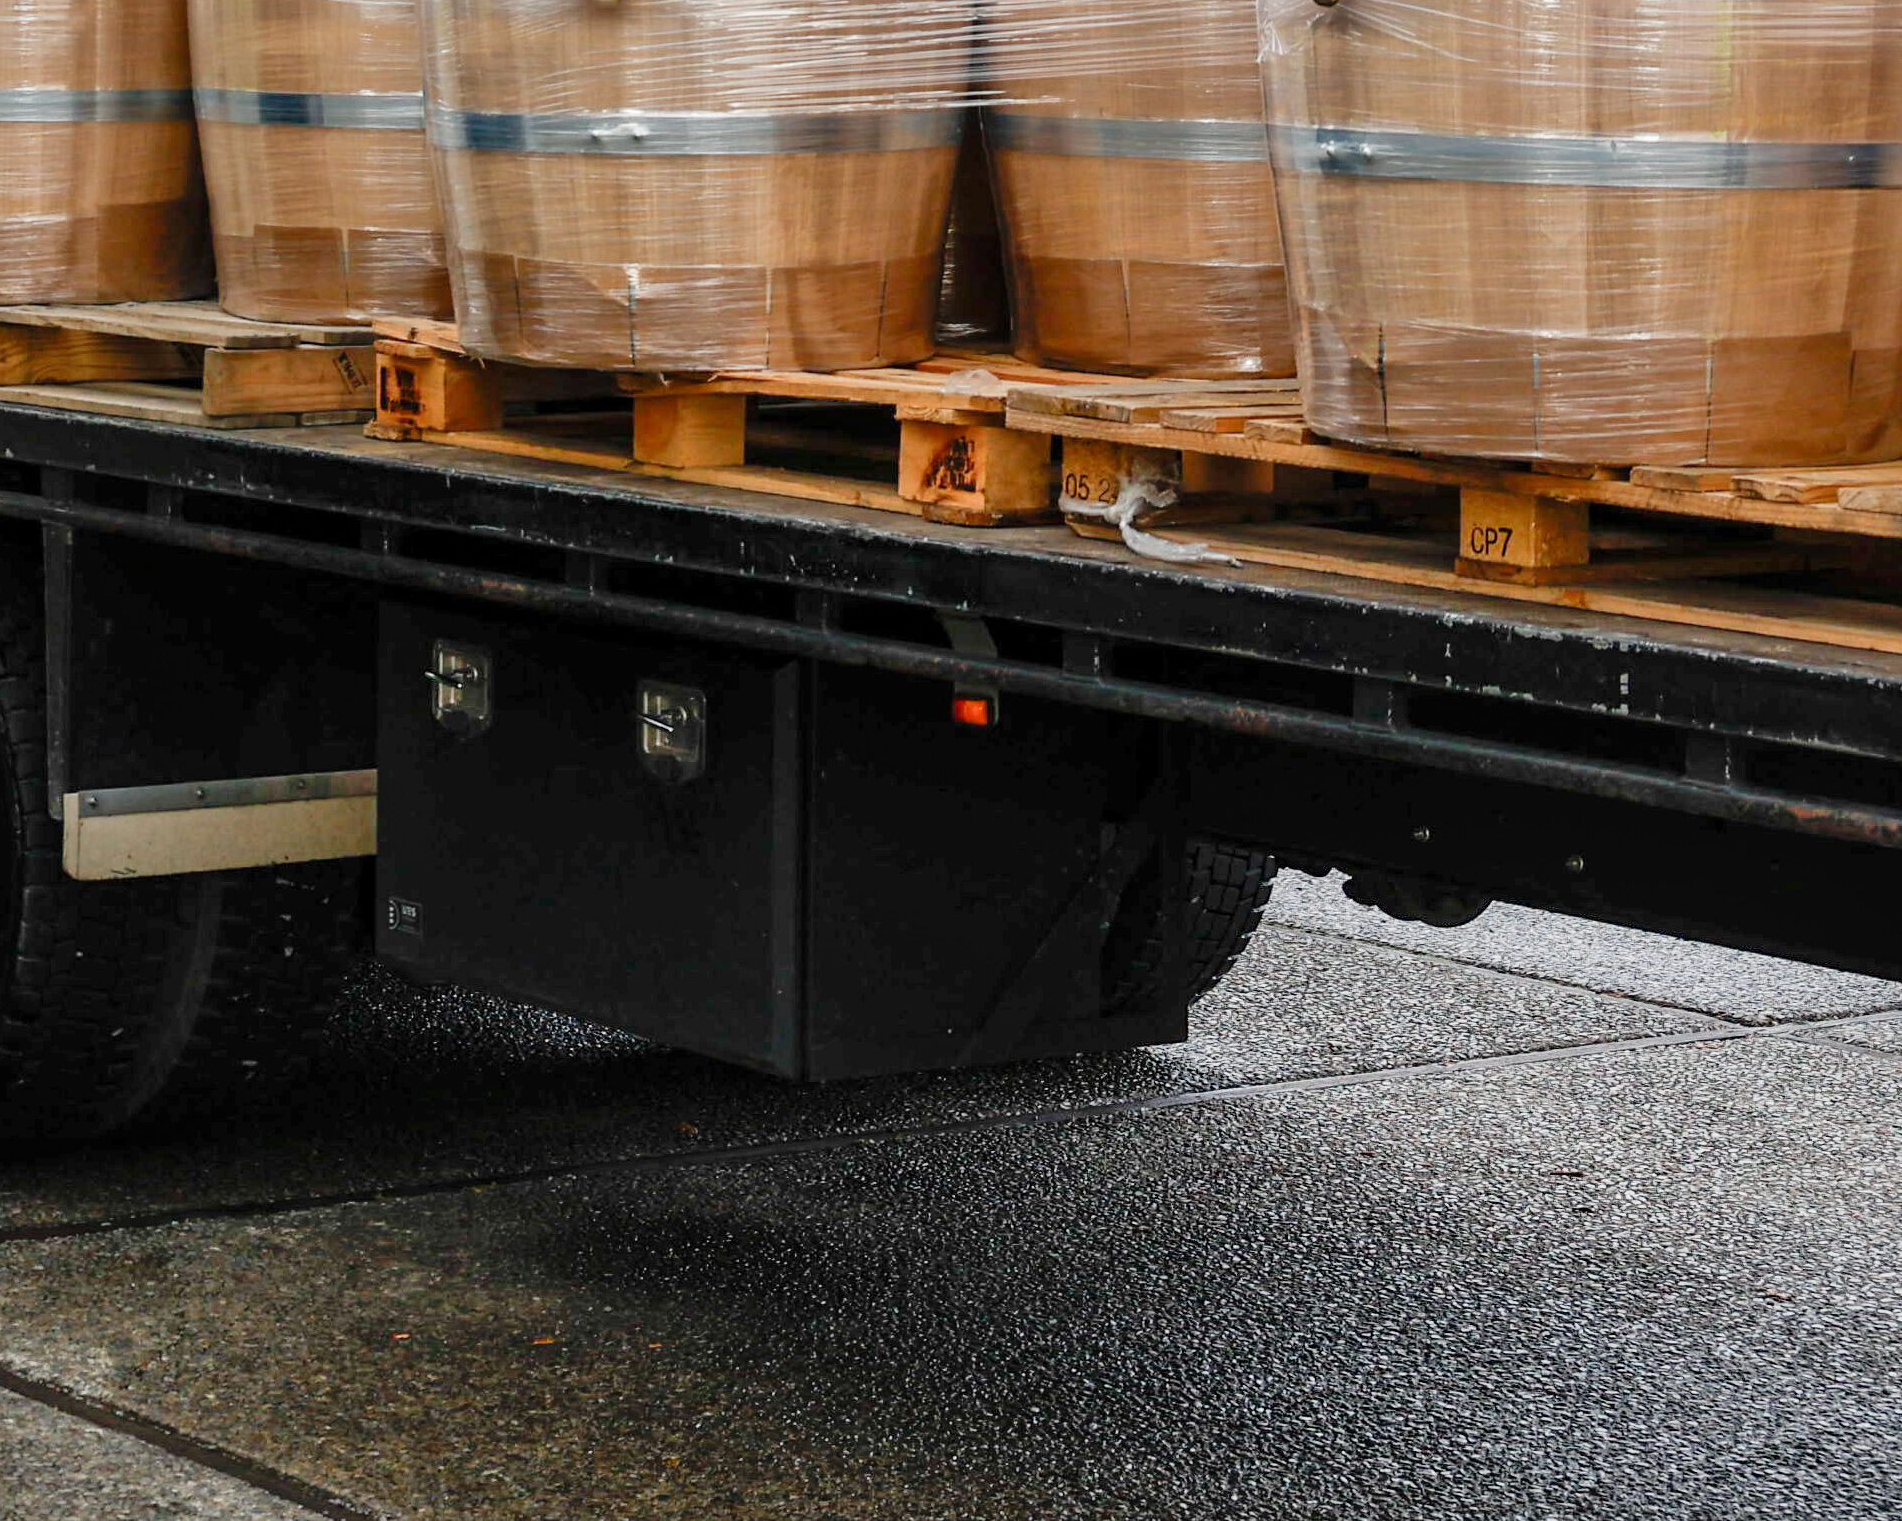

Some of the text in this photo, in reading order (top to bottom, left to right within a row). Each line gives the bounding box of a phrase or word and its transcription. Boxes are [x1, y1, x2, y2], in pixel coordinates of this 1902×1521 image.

[1065, 472, 1115, 503] 05 2
[1471, 526, 1513, 557] CP7
